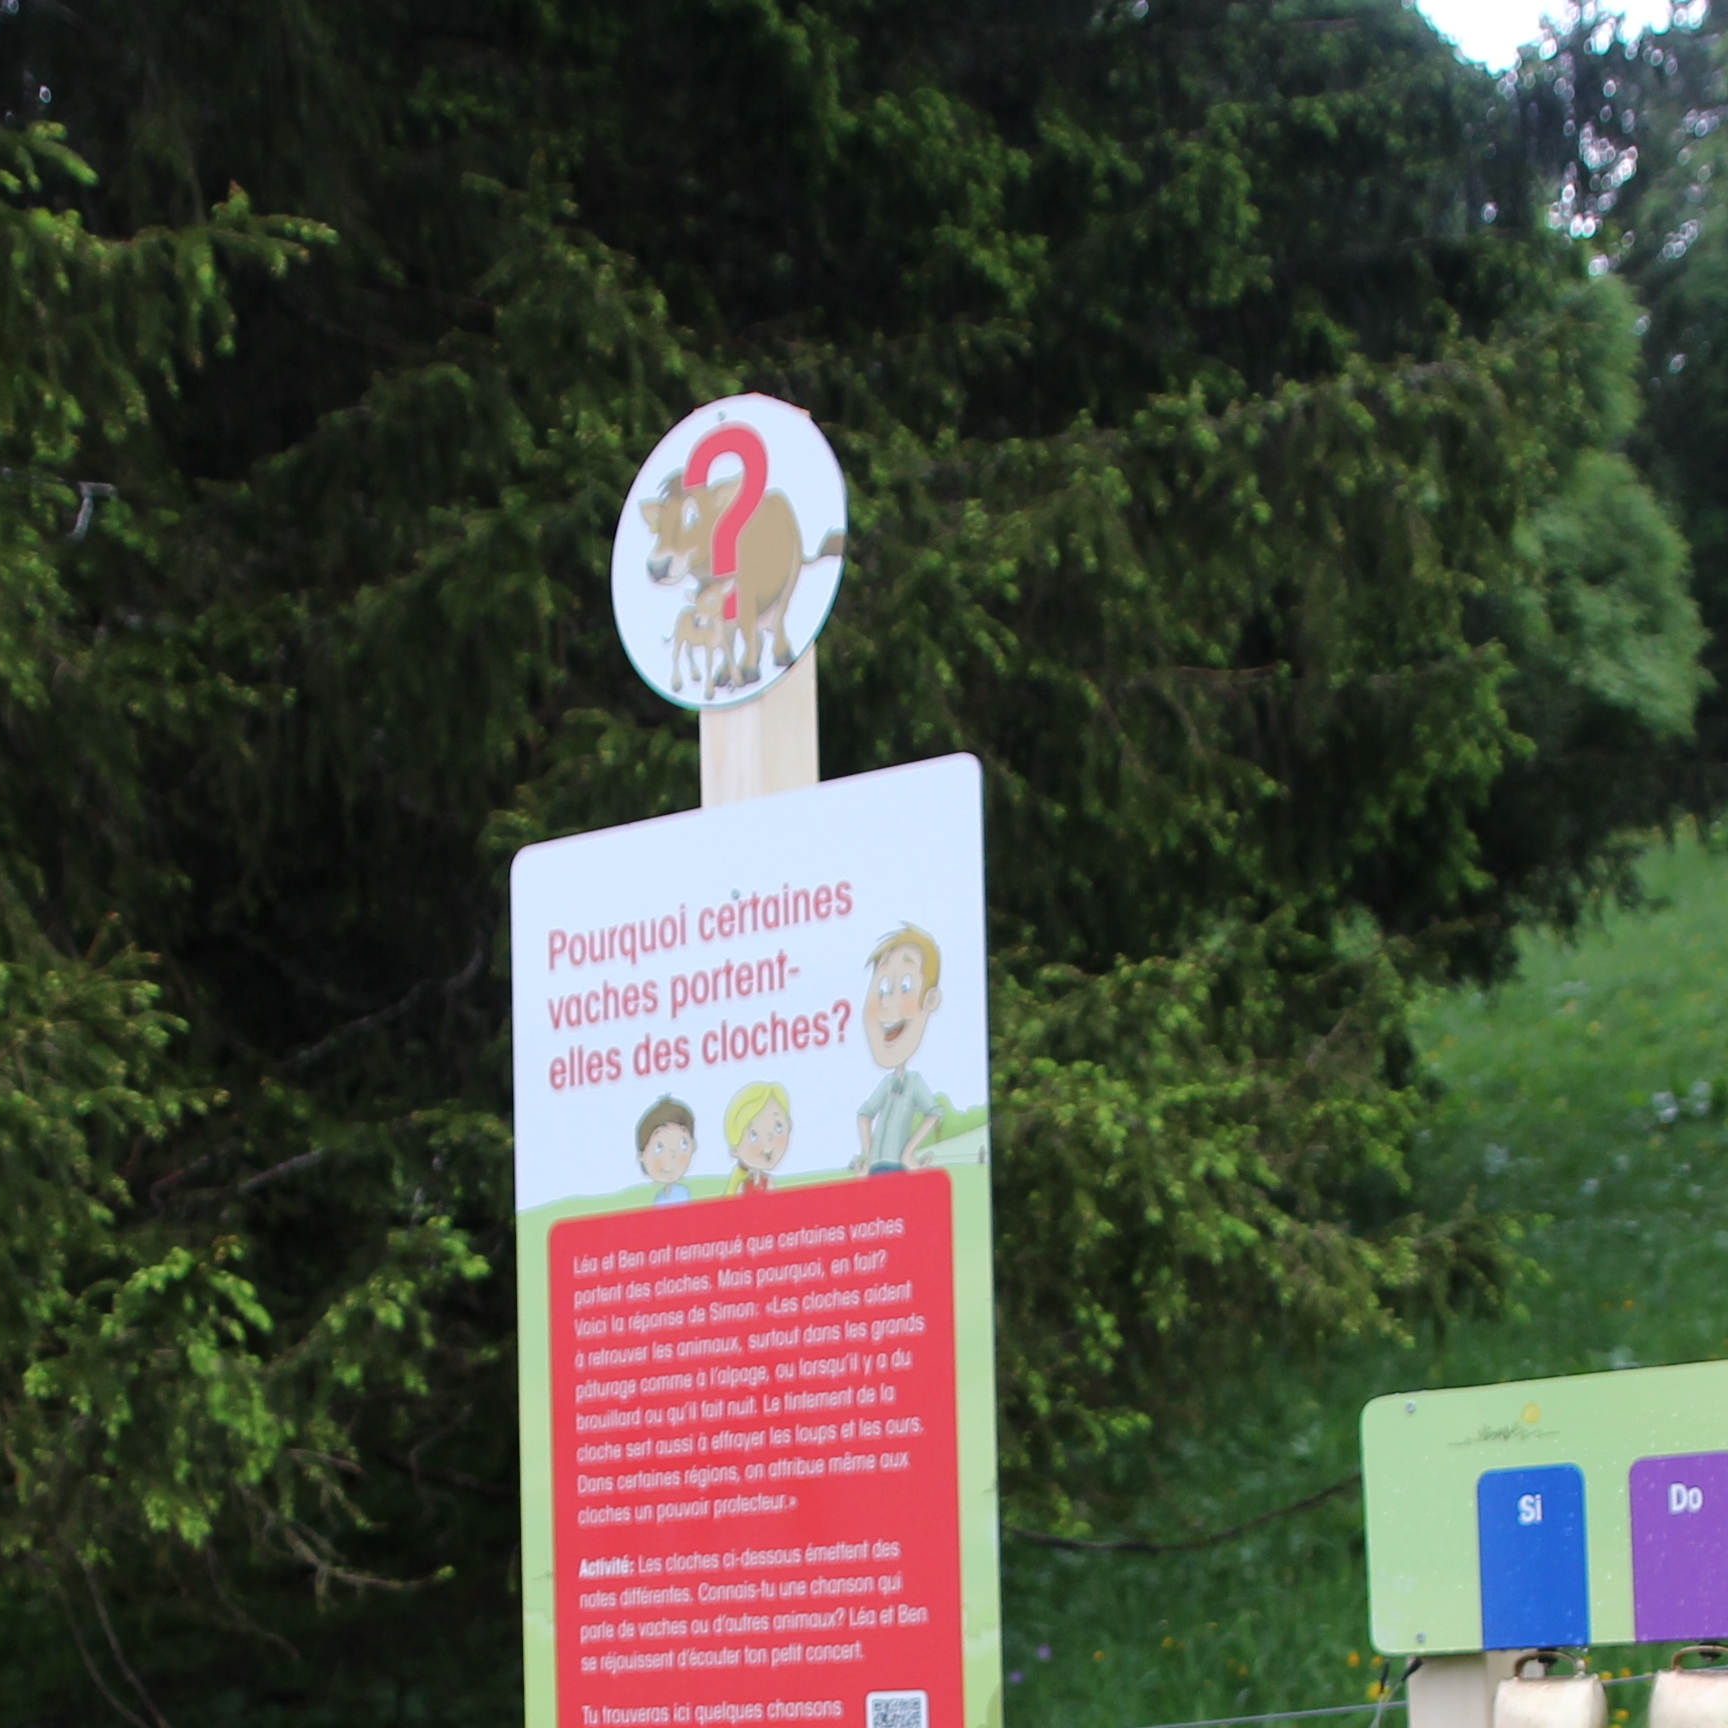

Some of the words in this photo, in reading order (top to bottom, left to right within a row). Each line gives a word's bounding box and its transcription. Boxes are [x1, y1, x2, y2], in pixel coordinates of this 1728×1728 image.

[548, 902, 687, 970] Pourquoi
[698, 880, 853, 942] certaines
[548, 979, 659, 1030] vaches
[671, 949, 801, 1019] portent-
[549, 1044, 622, 1091] elles
[633, 1033, 691, 1077] des
[702, 998, 852, 1065] cloches?
[574, 1255, 599, 1275] Léa
[602, 1253, 615, 1272] et
[618, 1249, 645, 1270] Ben
[649, 1245, 672, 1266] ont
[675, 1235, 743, 1262] remarqué
[747, 1234, 774, 1257] que
[778, 1225, 846, 1250] certaines
[850, 1217, 904, 1240] vaches
[574, 1283, 623, 1310] portent
[626, 1281, 651, 1301] des
[718, 1267, 753, 1290] Mais
[831, 1258, 850, 1276] en
[854, 1249, 888, 1273] fait?
[575, 1316, 607, 1337] Voici
[611, 1315, 625, 1334] la
[628, 1310, 684, 1334] réponse
[688, 1305, 706, 1325] de
[802, 1288, 860, 1312] cloches
[864, 1280, 912, 1305] aident
[575, 1350, 585, 1369] à
[588, 1346, 648, 1367] retrouver
[652, 1341, 673, 1361] les
[748, 1326, 800, 1350] surtout
[804, 1324, 841, 1345] dans
[845, 1320, 867, 1340] les
[871, 1313, 925, 1342] grands
[576, 1379, 636, 1403] pâturage
[640, 1373, 693, 1394] comme
[696, 1369, 707, 1388] à
[776, 1363, 795, 1380] ou
[863, 1354, 872, 1375] y
[877, 1353, 888, 1371] a
[891, 1348, 912, 1369] du
[576, 1407, 642, 1432] brouillard
[645, 1409, 664, 1425] ou
[701, 1399, 724, 1421] fait
[763, 1394, 780, 1414] Le
[784, 1387, 854, 1411] tintement
[857, 1384, 876, 1406] de
[880, 1383, 896, 1403] la
[577, 1442, 622, 1463] cloche
[626, 1438, 653, 1459] sert
[656, 1434, 694, 1456] aussi
[698, 1431, 708, 1452] à
[712, 1429, 765, 1452] effrayer
[770, 1427, 791, 1445] les
[795, 1424, 837, 1446] loups
[841, 1419, 856, 1440] et
[859, 1418, 882, 1439] les
[577, 1474, 613, 1494] Dans
[617, 1470, 681, 1491] certaines
[745, 1463, 765, 1481] on
[768, 1457, 825, 1479] attribue
[828, 1451, 877, 1474] même
[880, 1452, 909, 1470] aux
[578, 1505, 631, 1526] cloches
[635, 1505, 653, 1521] un
[656, 1497, 710, 1523] pouvoir
[1518, 1493, 1543, 1525] Si
[1667, 1482, 1704, 1515] Do
[638, 1555, 662, 1575] Les
[666, 1552, 720, 1573] cloches
[723, 1547, 802, 1569] ci-dessous
[805, 1540, 870, 1565] émettent
[872, 1539, 900, 1560] des
[580, 1590, 617, 1609] notes
[698, 1579, 776, 1602] Connais-tu
[779, 1580, 807, 1598] une
[810, 1576, 875, 1596] chanson
[878, 1572, 903, 1595] qui
[580, 1621, 615, 1644] parle
[618, 1619, 635, 1639] de
[639, 1618, 688, 1638] vaches
[691, 1619, 710, 1635] ou
[773, 1607, 847, 1631] animaux?
[849, 1606, 877, 1627] Léa
[880, 1605, 895, 1627] et
[897, 1604, 928, 1626] Ben
[581, 1656, 597, 1672] se
[600, 1649, 675, 1675] réjouissent
[744, 1646, 768, 1665] ton
[771, 1642, 803, 1667] petit
[584, 1705, 599, 1725] Tu
[602, 1706, 670, 1725] trouveras
[673, 1703, 691, 1722] ici
[695, 1701, 763, 1726] quelques
[767, 1699, 843, 1720] chansons
